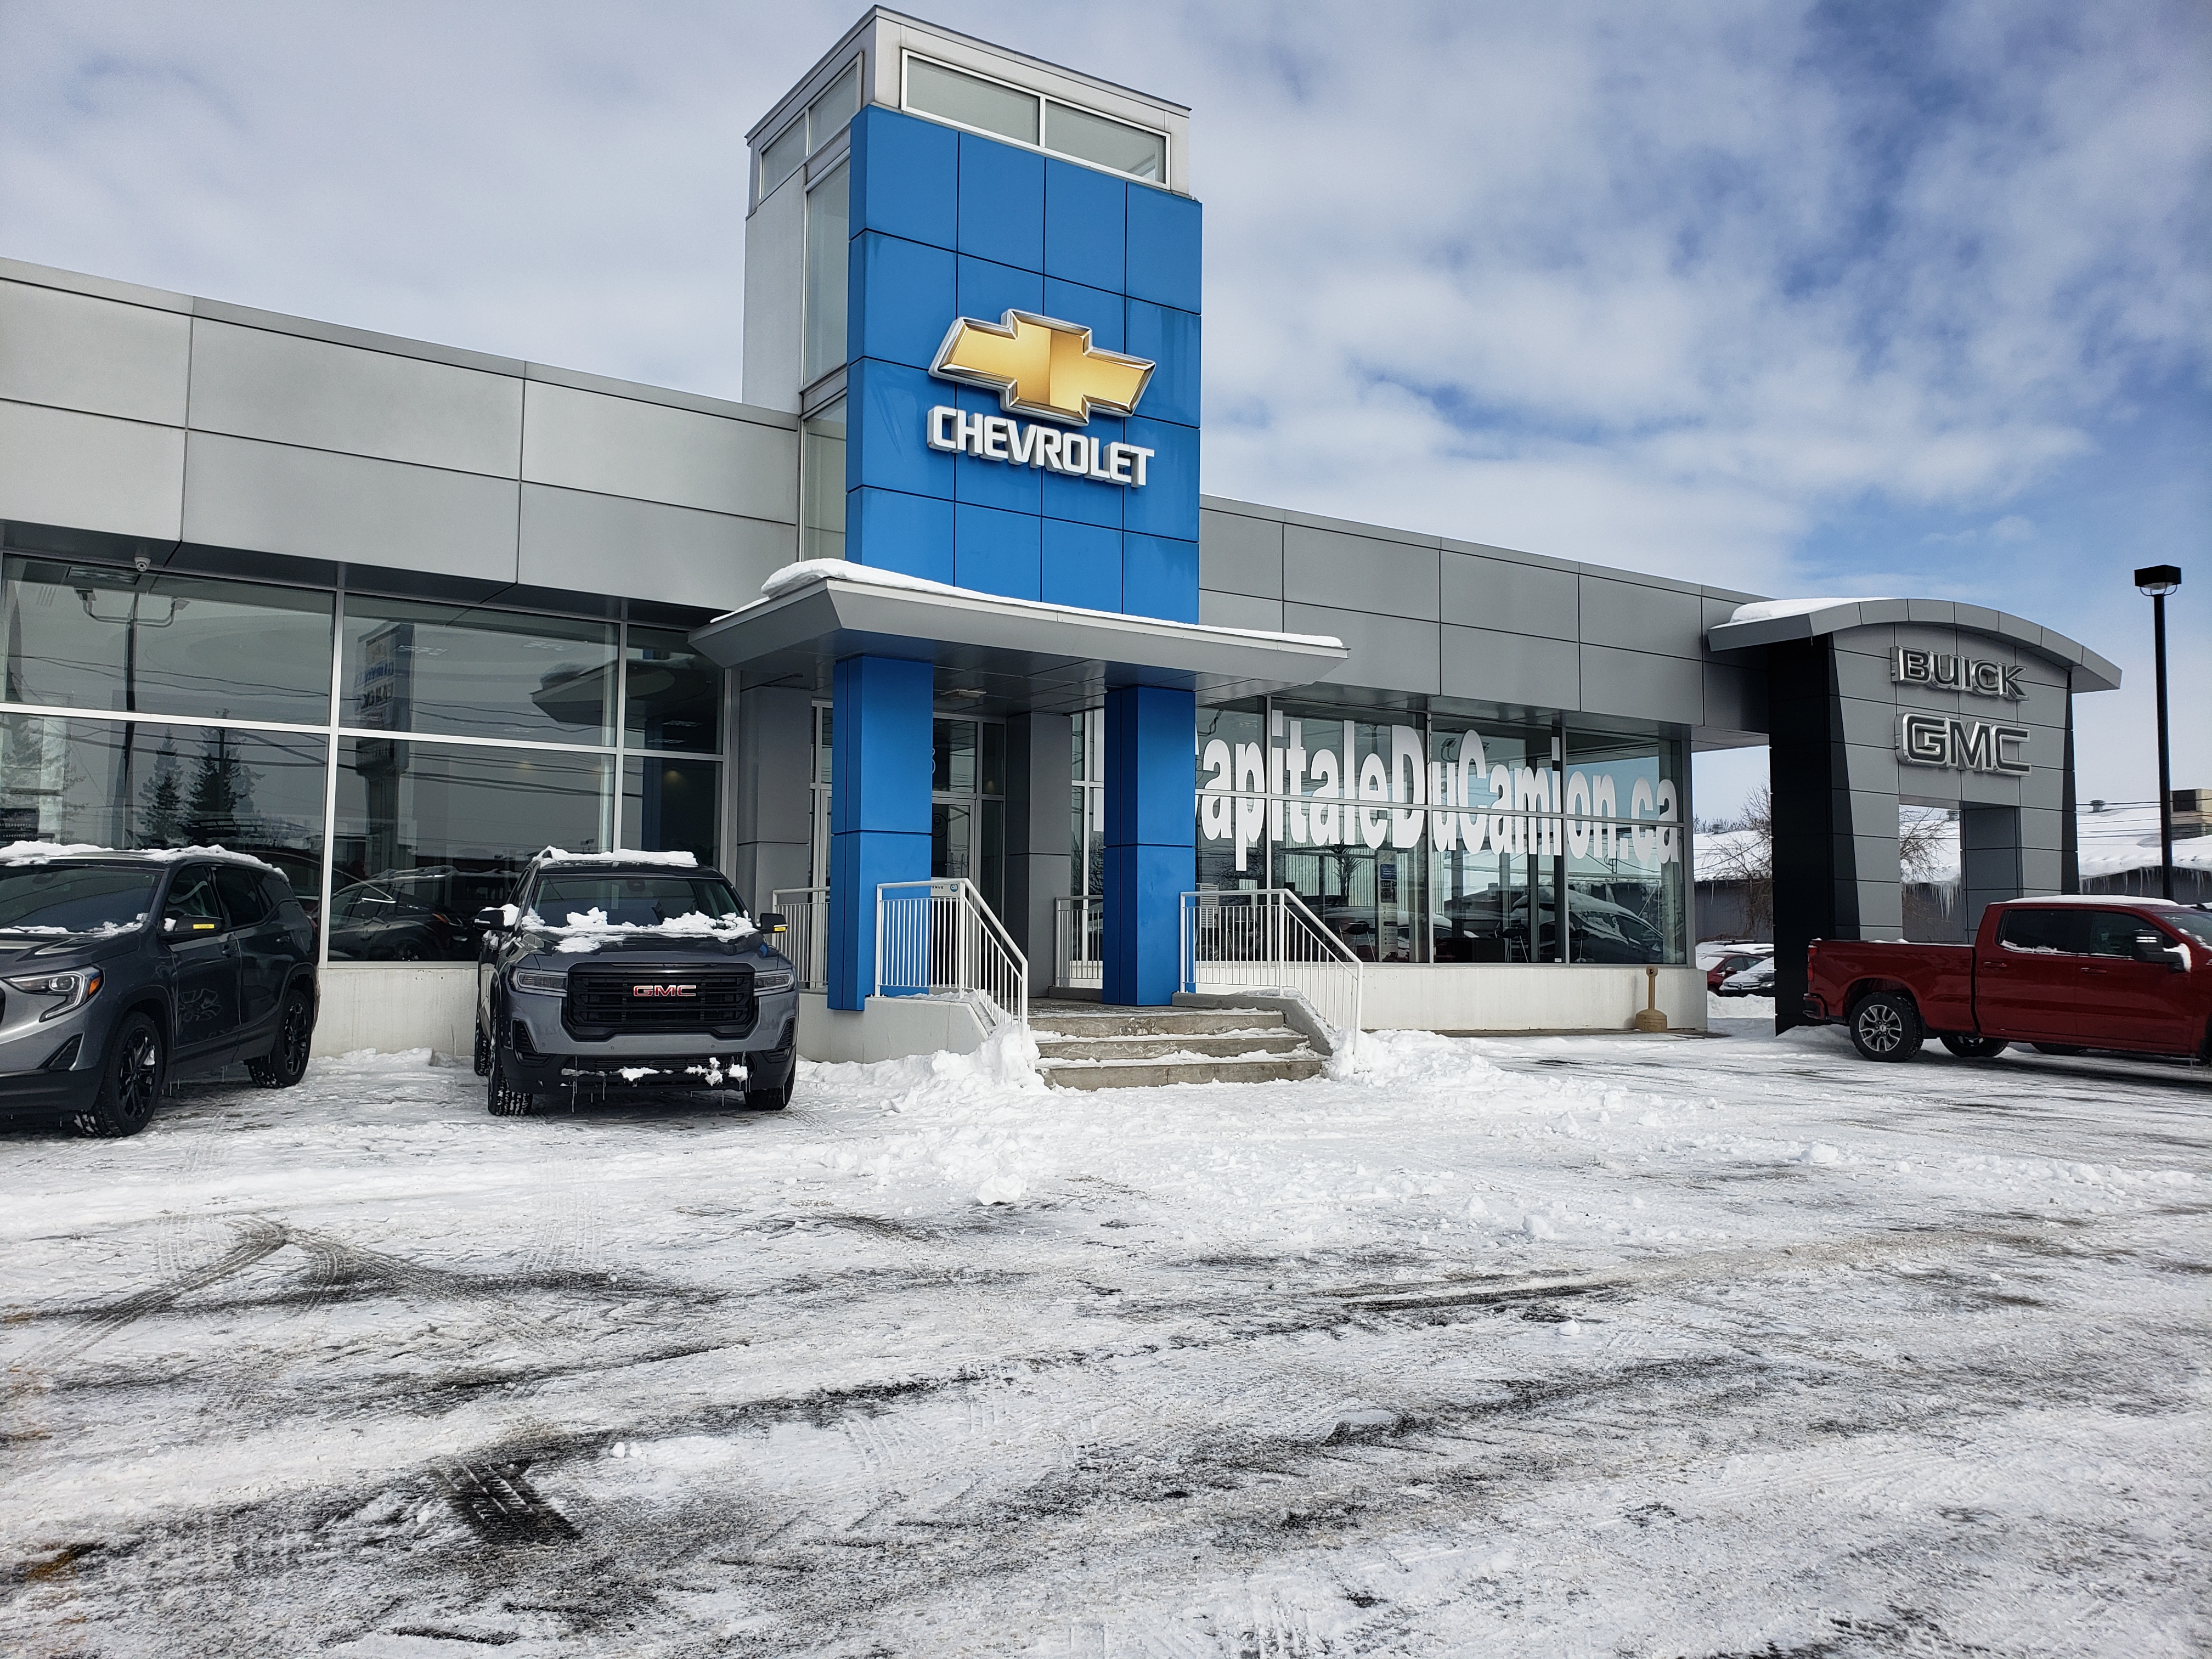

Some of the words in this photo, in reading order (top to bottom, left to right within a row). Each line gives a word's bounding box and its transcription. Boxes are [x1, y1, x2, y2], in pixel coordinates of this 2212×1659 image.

[927, 405, 1155, 488] CHEVROLET
[1891, 646, 2029, 701] BUICK
[1894, 712, 2032, 777] GMC
[633, 985, 697, 997] GMC
